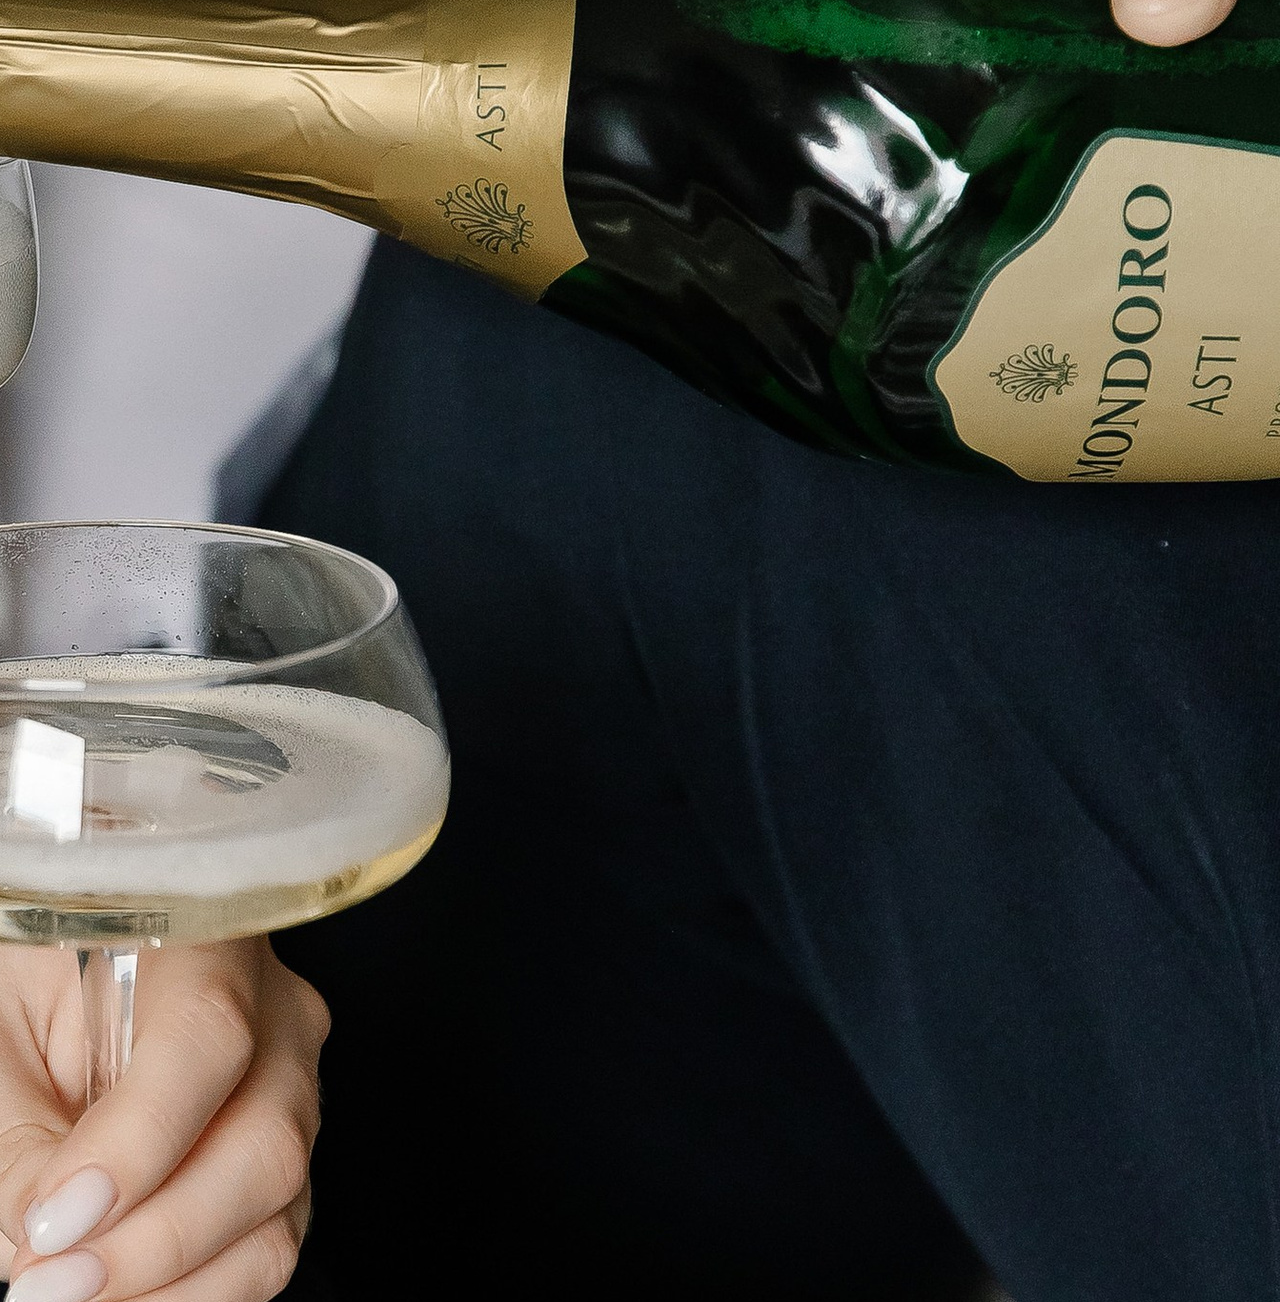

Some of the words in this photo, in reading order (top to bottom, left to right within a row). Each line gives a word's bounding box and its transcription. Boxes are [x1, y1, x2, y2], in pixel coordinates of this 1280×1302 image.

[474, 62, 508, 152] ASTI
[1067, 183, 1173, 479] MONDORO
[1186, 335, 1241, 416] ASTI
